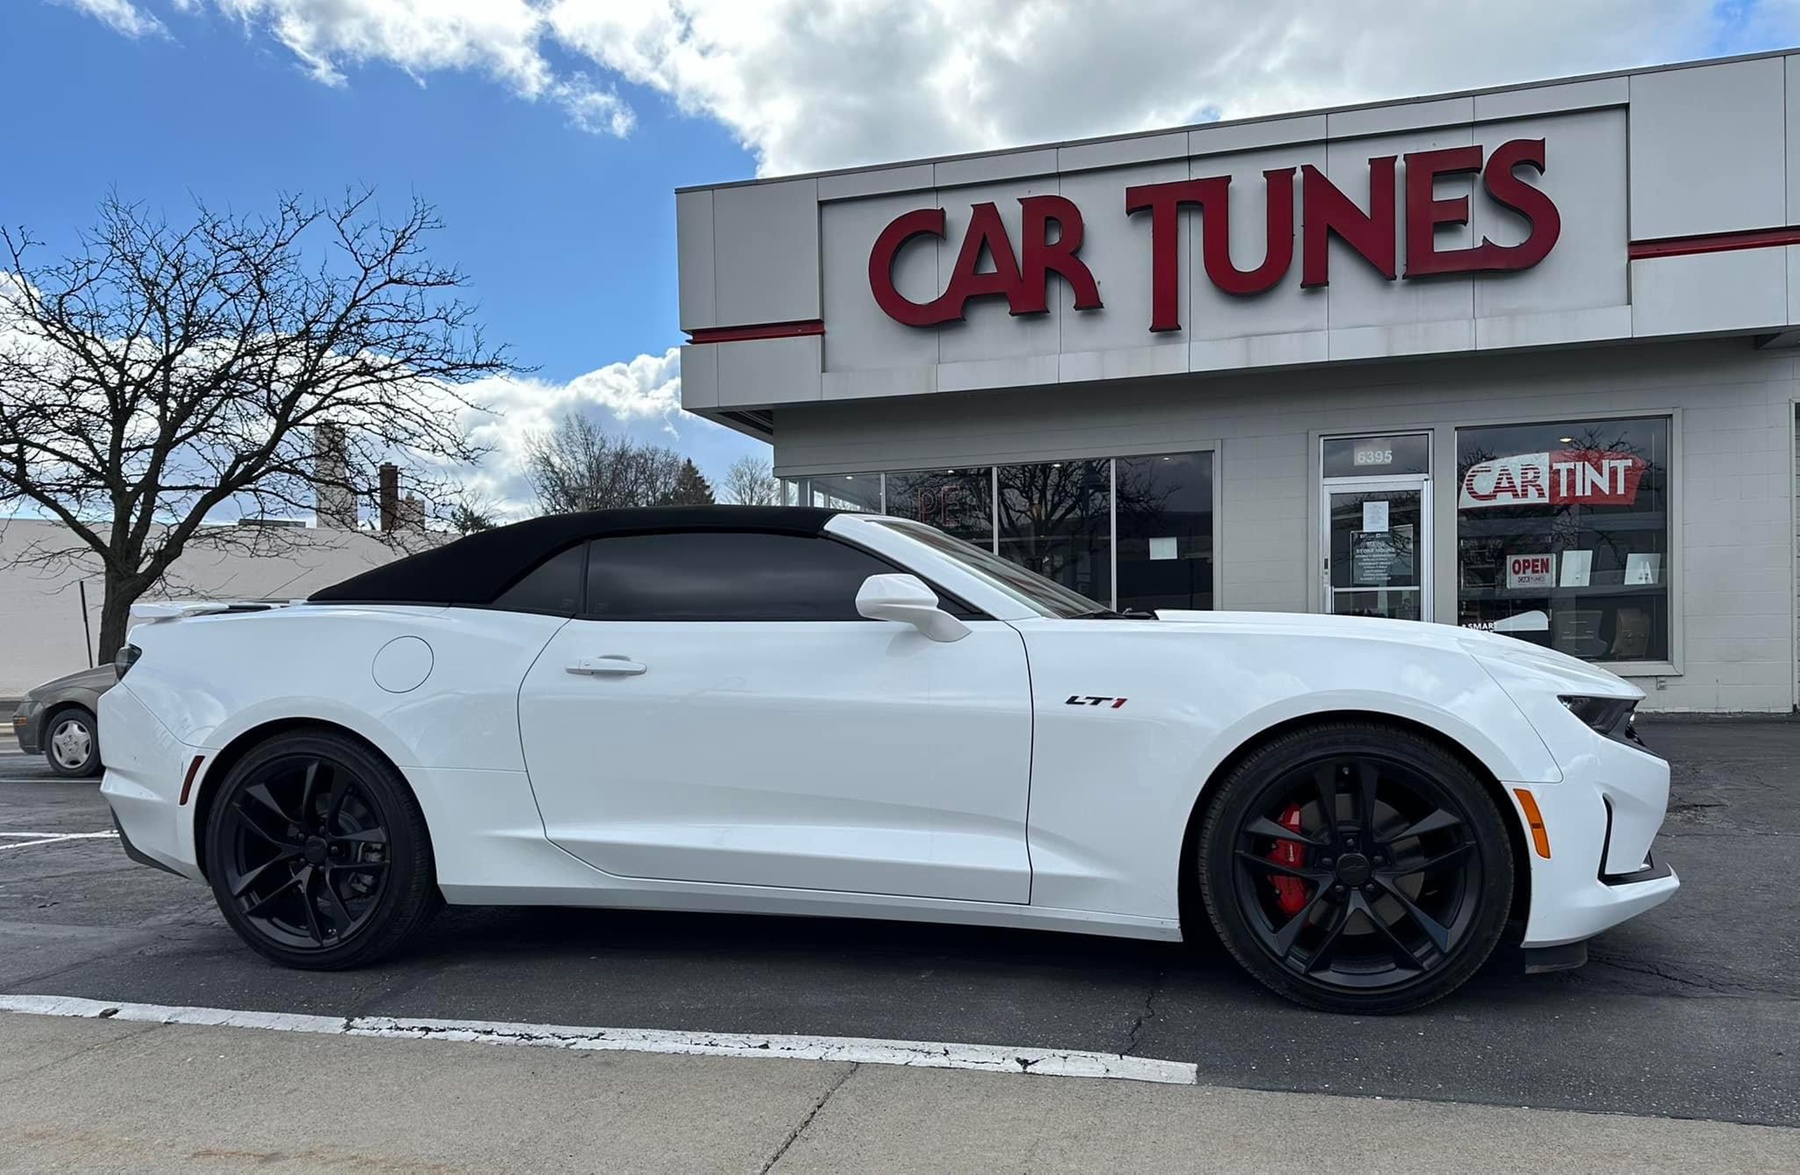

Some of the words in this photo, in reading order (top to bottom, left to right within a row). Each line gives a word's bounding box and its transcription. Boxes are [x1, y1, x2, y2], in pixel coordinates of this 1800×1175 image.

[868, 193, 1104, 329] CAR
[1126, 137, 1561, 334] TUNES
[1357, 450, 1393, 464] 6395
[1465, 463, 1547, 501] CAR
[1552, 458, 1633, 498] TINT
[1511, 557, 1550, 575] OPEN
[1064, 695, 1128, 709] LT1
